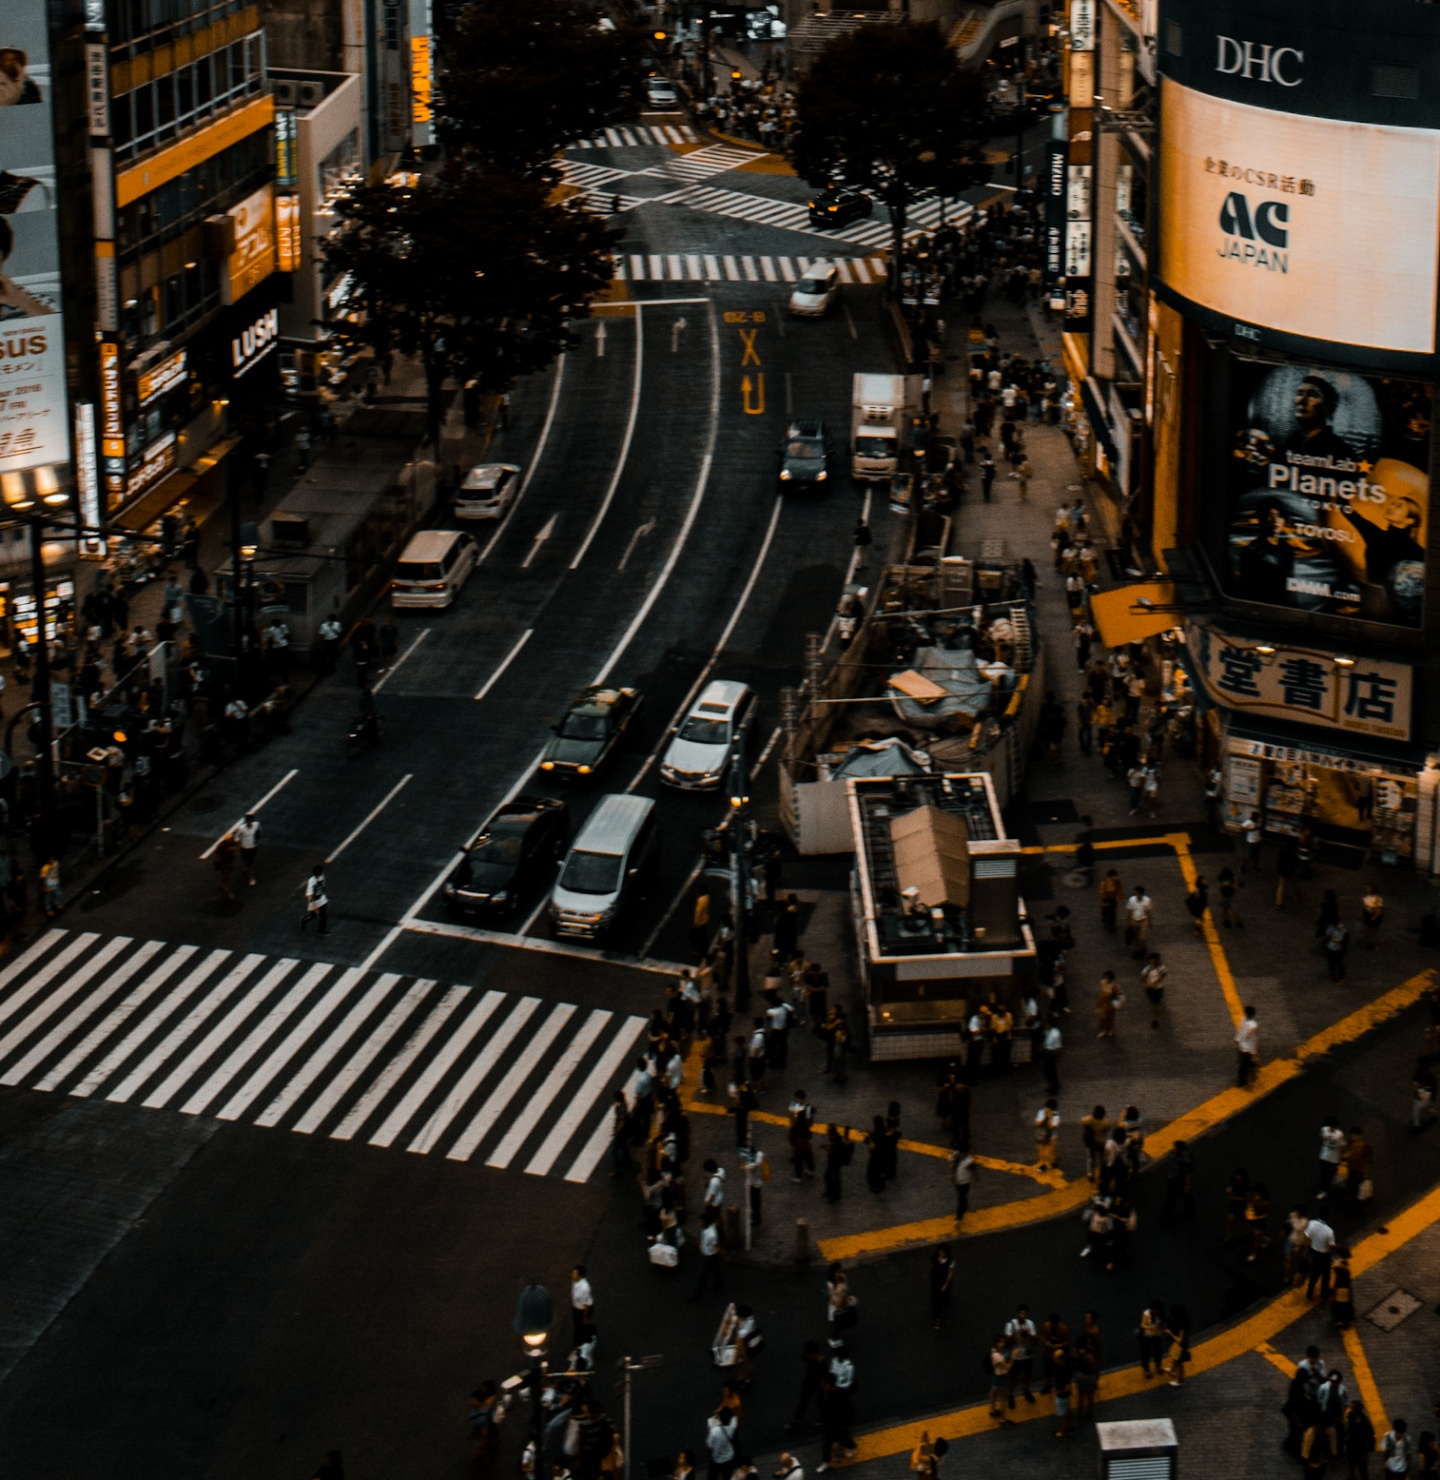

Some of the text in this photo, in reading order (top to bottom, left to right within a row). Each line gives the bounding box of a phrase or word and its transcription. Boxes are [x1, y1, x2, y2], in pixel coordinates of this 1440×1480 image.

[1216, 34, 1304, 87] DHC
[1203, 156, 1316, 197] 企業のCSR活動
[1219, 191, 1290, 249] AC
[1216, 238, 1288, 274] JAPAN
[232, 308, 278, 367] LUSH
[1286, 450, 1357, 473] teamLab
[1268, 463, 1387, 504] Planets
[1294, 521, 1357, 544] TOYOSU
